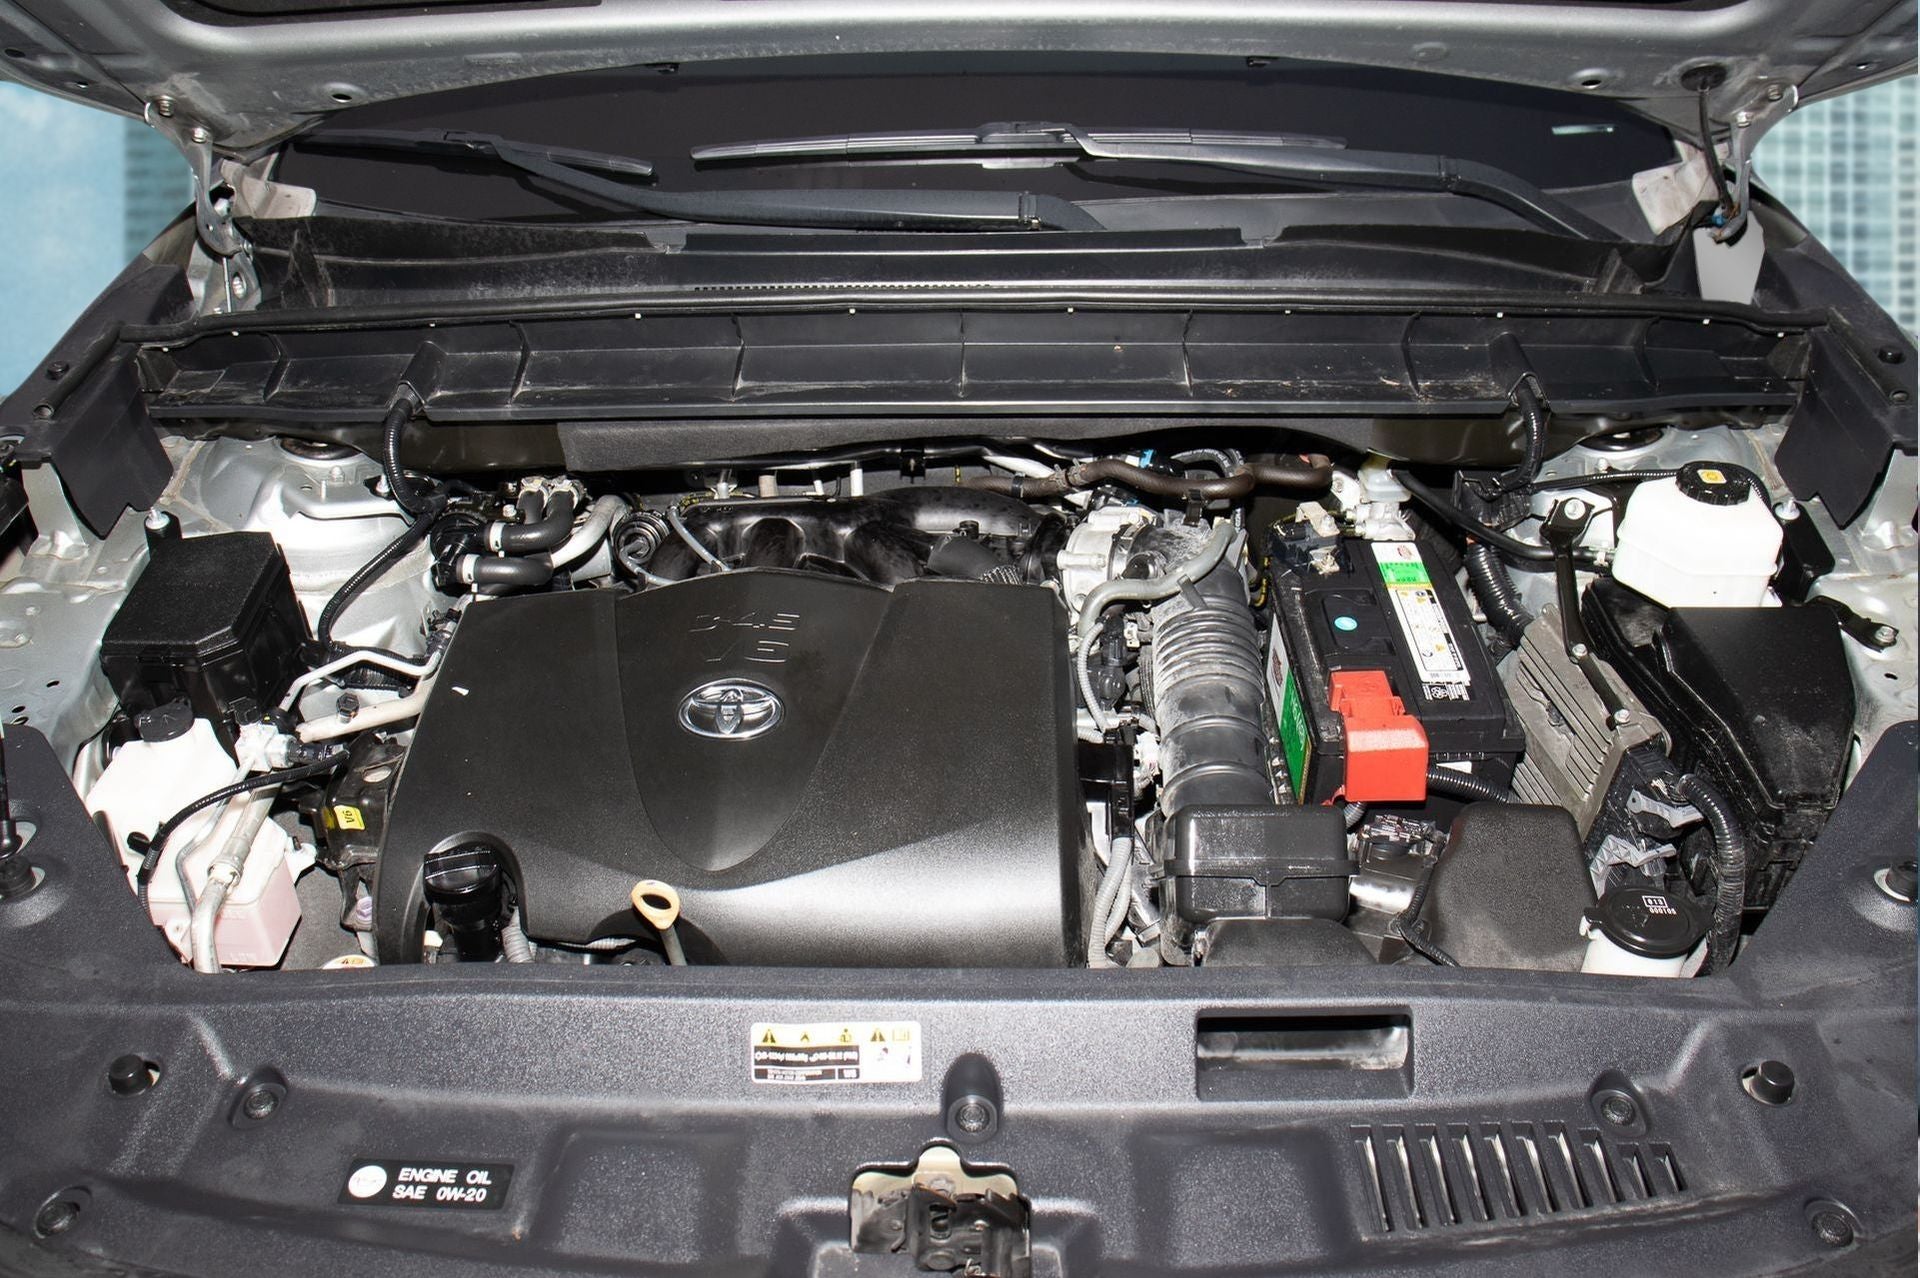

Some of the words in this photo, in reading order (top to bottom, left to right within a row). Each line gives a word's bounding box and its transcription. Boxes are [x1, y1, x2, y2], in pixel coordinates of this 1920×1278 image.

[398, 1167, 459, 1183] ENGINE
[466, 1170, 493, 1185] OIL
[392, 1185, 427, 1200] SAE
[436, 1187, 487, 1203] 0W-20
